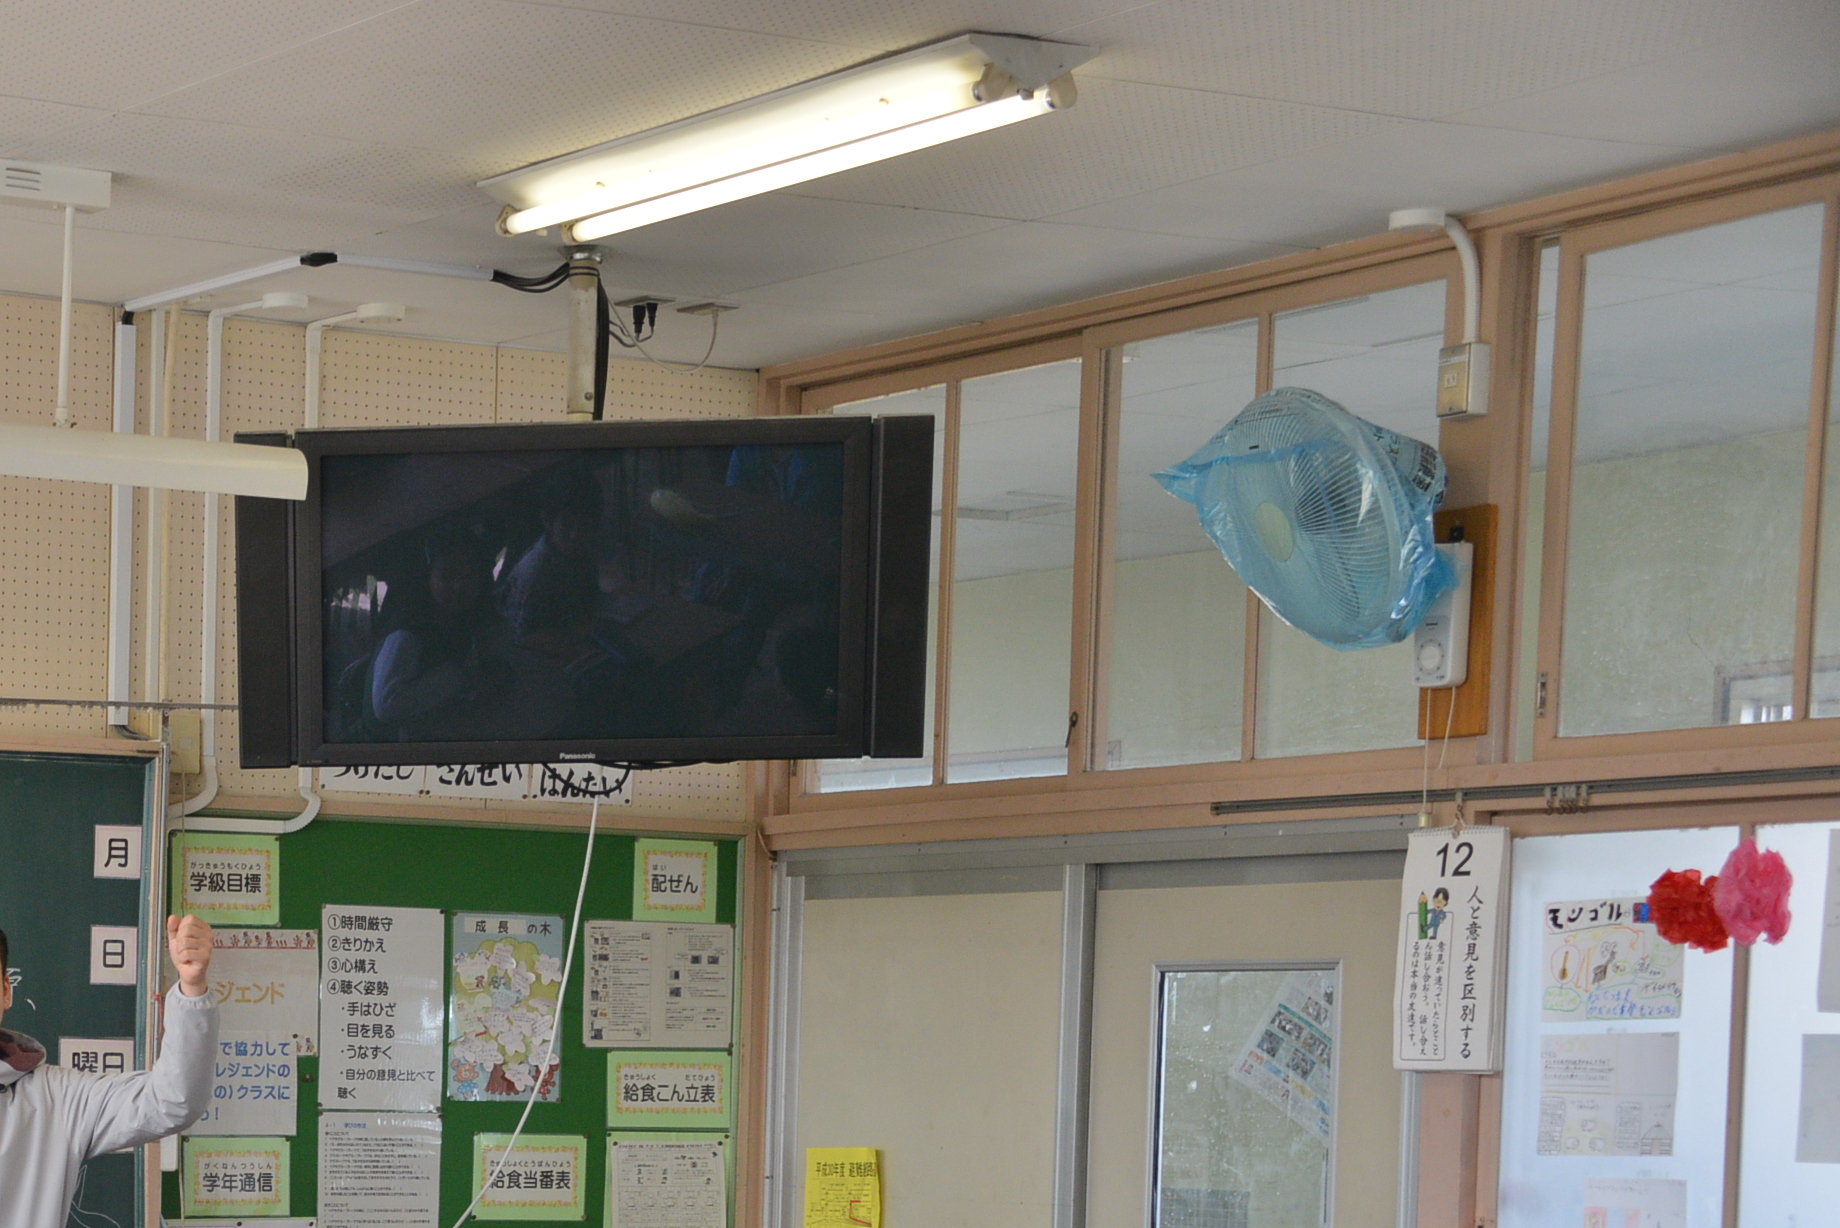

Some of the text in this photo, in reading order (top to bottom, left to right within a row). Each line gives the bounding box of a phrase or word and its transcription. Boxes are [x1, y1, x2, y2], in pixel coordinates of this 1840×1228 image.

[559, 752, 596, 761] Panasonic
[104, 838, 129, 868] 月
[1436, 841, 1475, 878] 12
[190, 861, 262, 870] がっきゅうもくひょう
[189, 872, 262, 894] 学級目標
[651, 873, 699, 894] 配ぜん
[327, 914, 393, 932] ①時間厳守
[474, 920, 552, 936] 成長の木
[328, 935, 387, 953] ②きりかえ
[102, 939, 125, 968] 日
[328, 957, 378, 974] ③心構え
[1460, 885, 1484, 1059] 人と意見を区別する
[327, 978, 389, 997] ④聴く姿勢
[341, 1002, 396, 1018] ・手はひざ
[341, 1023, 396, 1039] ・目を見る
[220, 1041, 291, 1056] で協力して
[71, 1051, 125, 1073] 曜日
[216, 1063, 291, 1078] レジェンドの
[340, 1068, 436, 1082] ・自分の意見と比べて
[337, 1087, 357, 1099] 聴く
[623, 1082, 716, 1103] 給食こん立表
[203, 1162, 273, 1170] がくねんつうしん
[202, 1173, 273, 1193] 学年通信
[489, 1169, 572, 1191] 給食当番表
